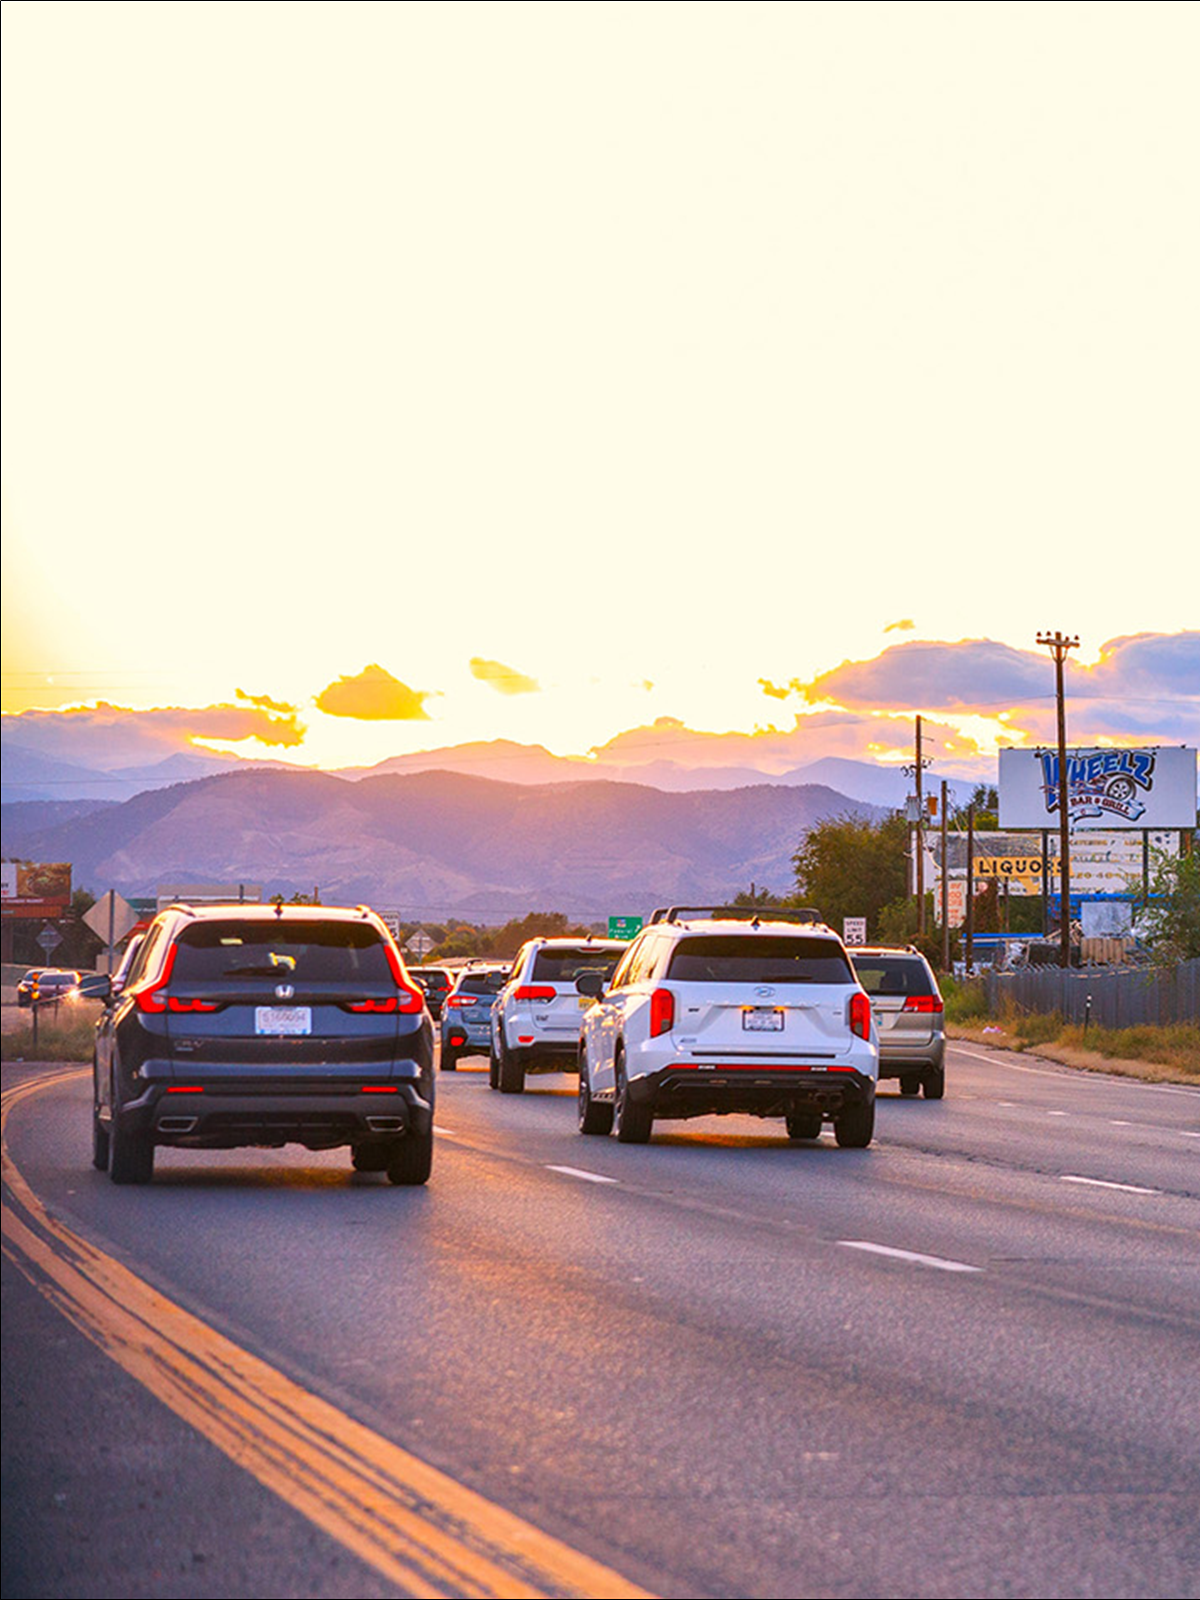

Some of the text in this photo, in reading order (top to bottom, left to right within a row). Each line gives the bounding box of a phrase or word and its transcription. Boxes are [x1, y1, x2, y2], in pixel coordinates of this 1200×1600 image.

[1041, 752, 1154, 811] WHEELZ
[1070, 796, 1093, 806] BAR
[1102, 798, 1129, 815] GRILL
[846, 933, 863, 945] 55
